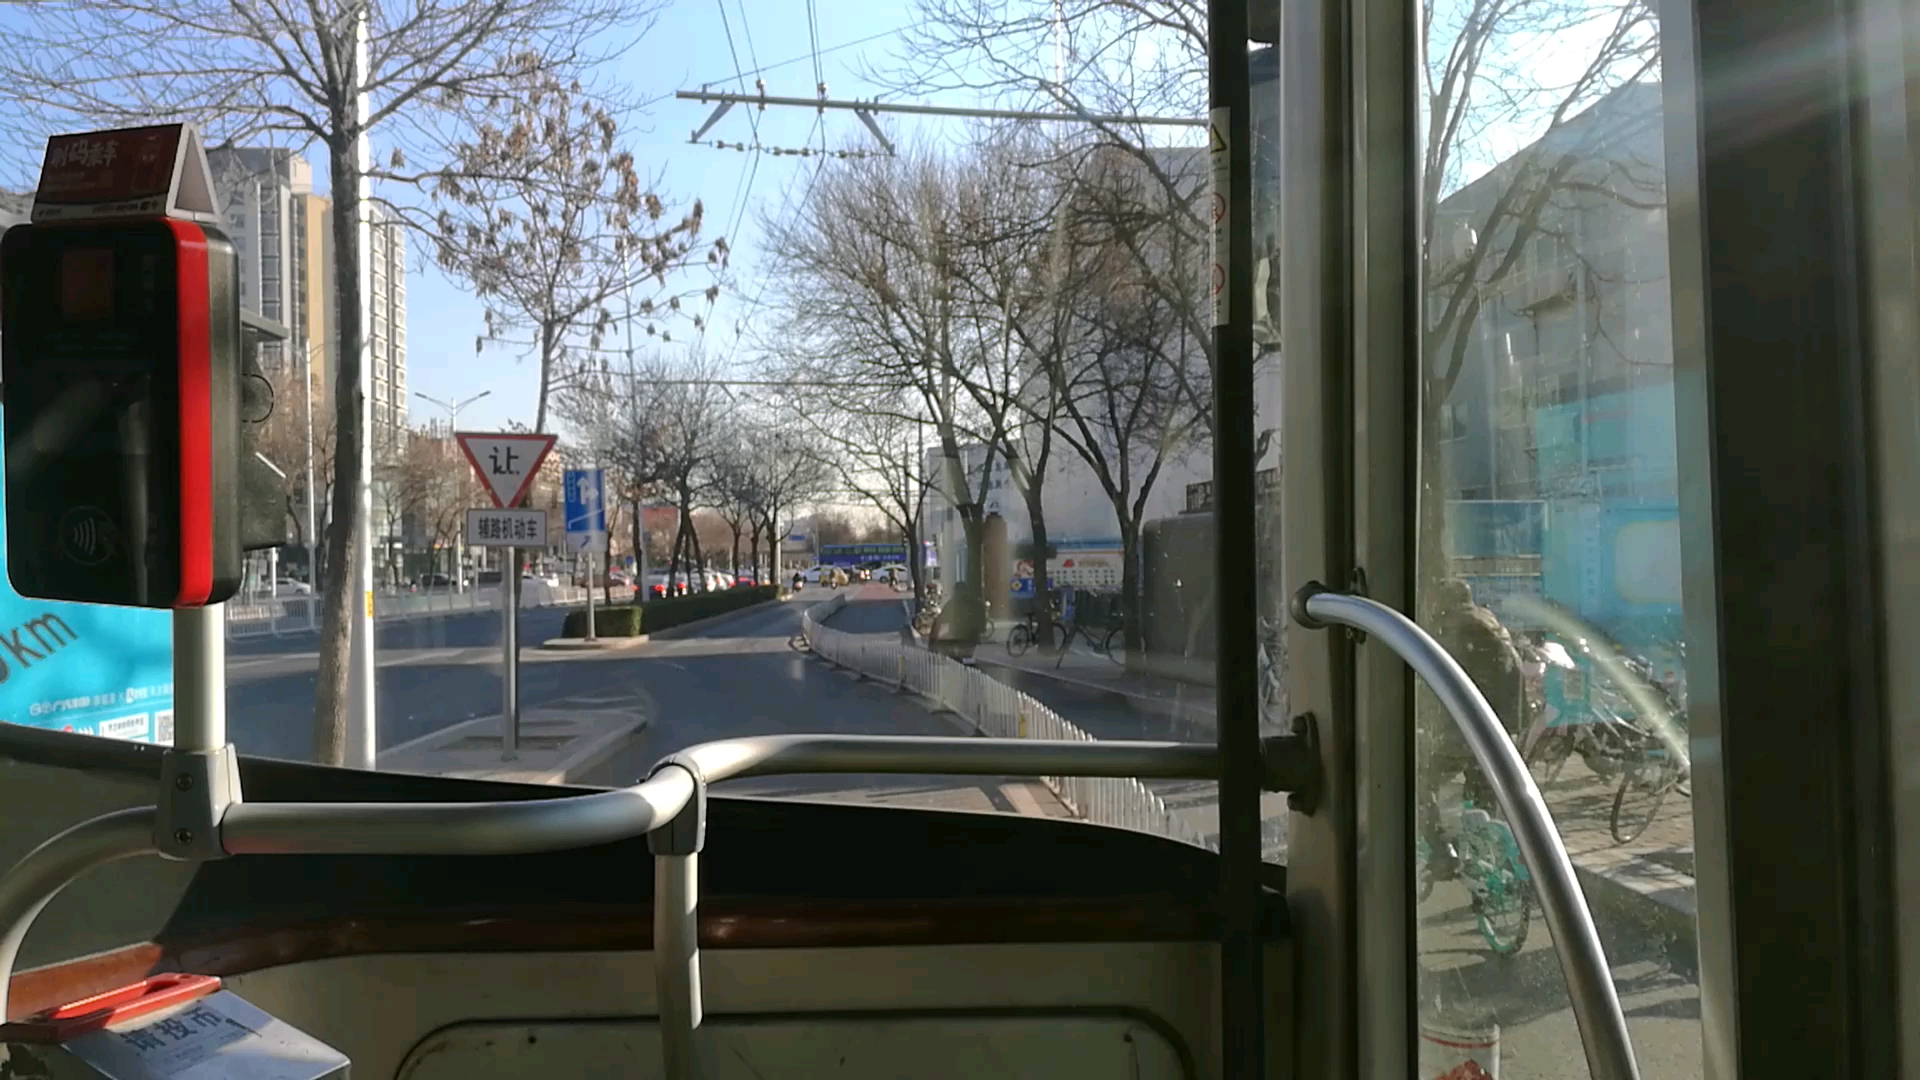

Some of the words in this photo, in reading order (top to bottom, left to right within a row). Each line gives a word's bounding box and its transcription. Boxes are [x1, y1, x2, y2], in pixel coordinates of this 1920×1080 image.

[489, 446, 520, 475] 让
[478, 516, 538, 540] 辅路机动车
[120, 1006, 222, 1051] 请投币
